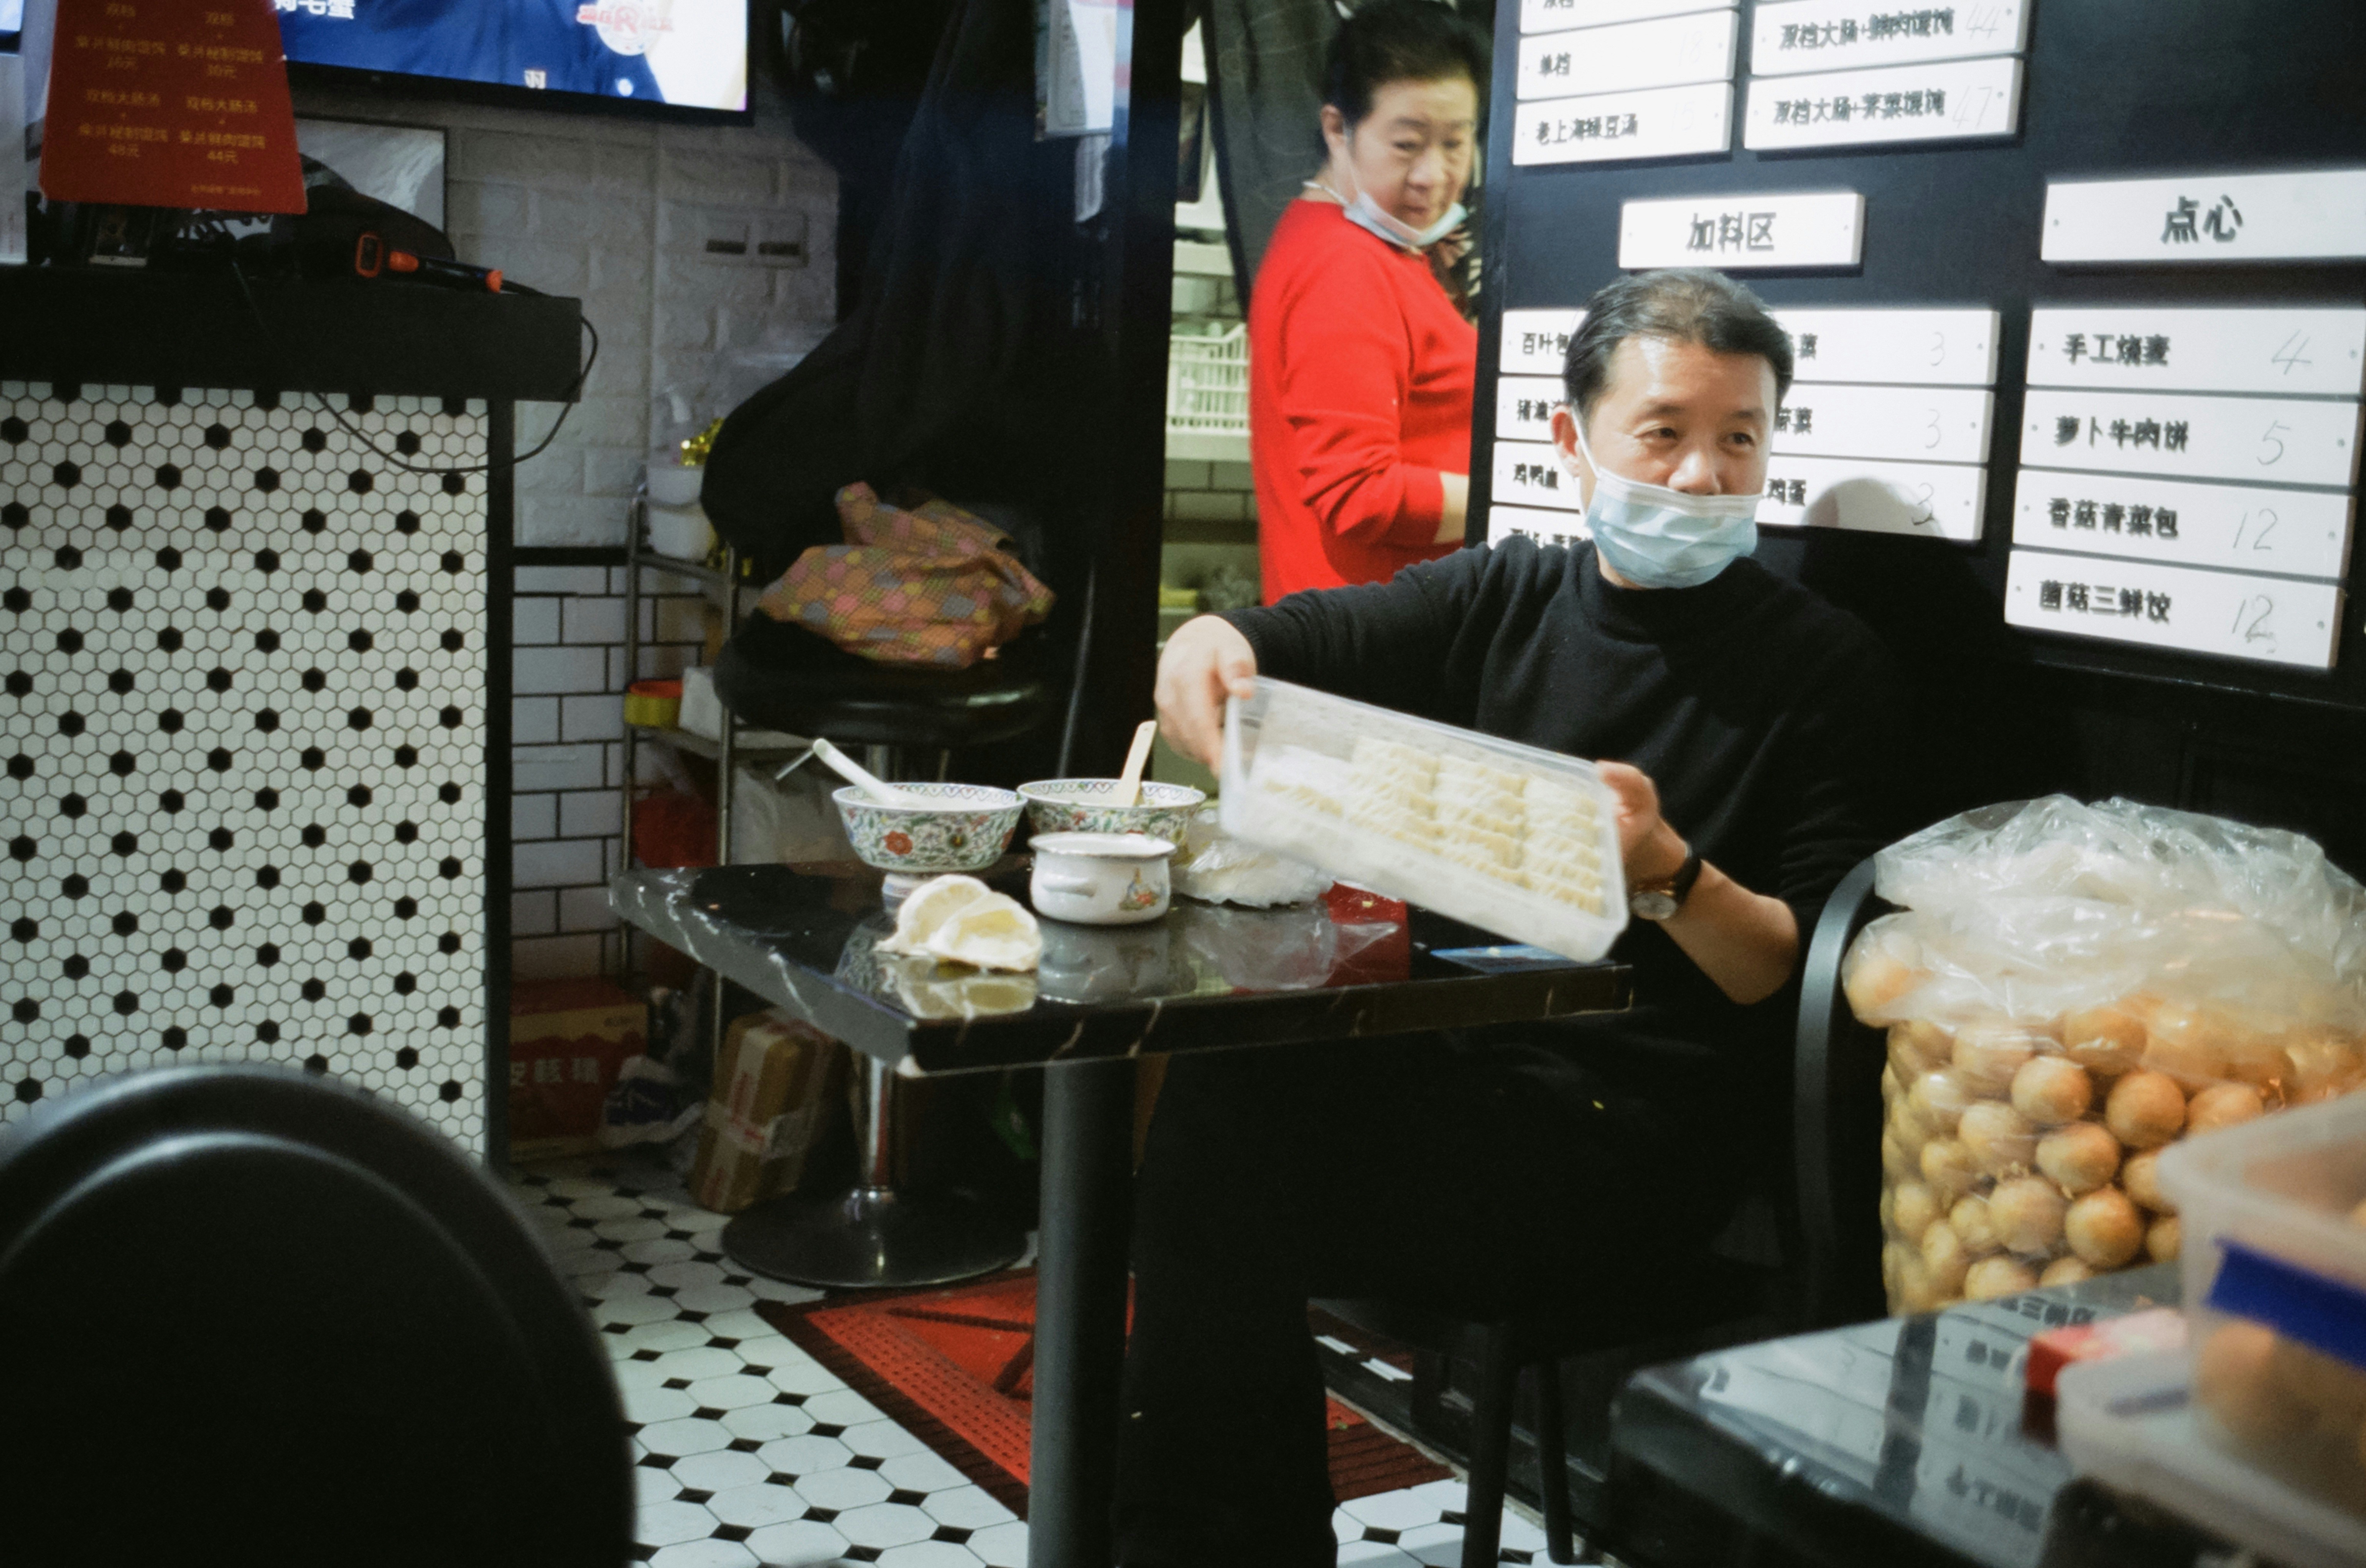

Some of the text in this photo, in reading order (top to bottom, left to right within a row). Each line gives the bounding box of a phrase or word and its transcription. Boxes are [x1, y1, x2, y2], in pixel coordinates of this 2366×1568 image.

[1686, 212, 1777, 253] 加料区
[2160, 194, 2244, 244] 点心
[1930, 331, 1944, 366] 3
[2062, 332, 2171, 366] 手工烧麦
[2271, 329, 2312, 375] 4
[1925, 408, 1941, 449] 3
[2053, 416, 2189, 452] 萝卜牛肉饼
[2256, 420, 2290, 466] 5
[2048, 497, 2179, 539] 香菇青菜包
[2233, 508, 2278, 550] 12
[2231, 594, 2275, 639] 12
